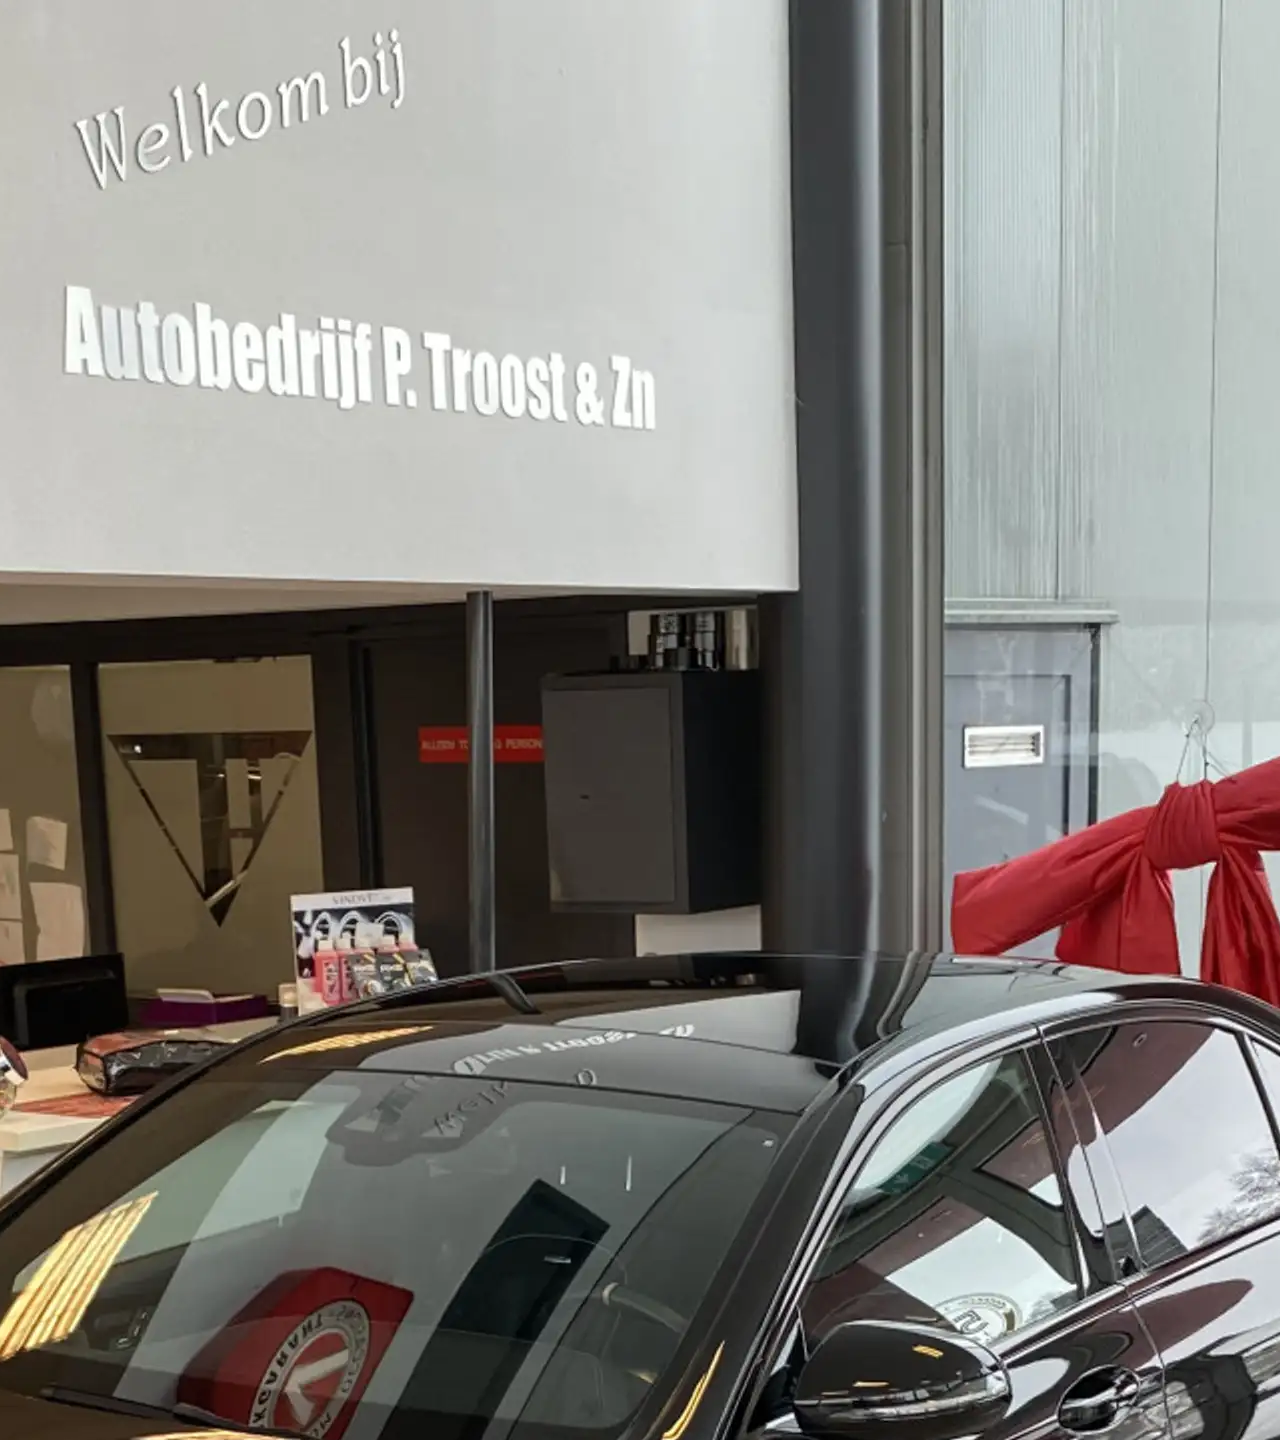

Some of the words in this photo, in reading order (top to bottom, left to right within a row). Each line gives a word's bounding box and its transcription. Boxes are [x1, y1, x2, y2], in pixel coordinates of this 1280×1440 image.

[74, 81, 329, 190] Welkom
[338, 28, 405, 109] bij
[63, 284, 373, 410] Autobedrijf
[382, 326, 416, 409] P.
[422, 331, 567, 423] Troost
[575, 361, 605, 426] &
[610, 355, 657, 430] Zn
